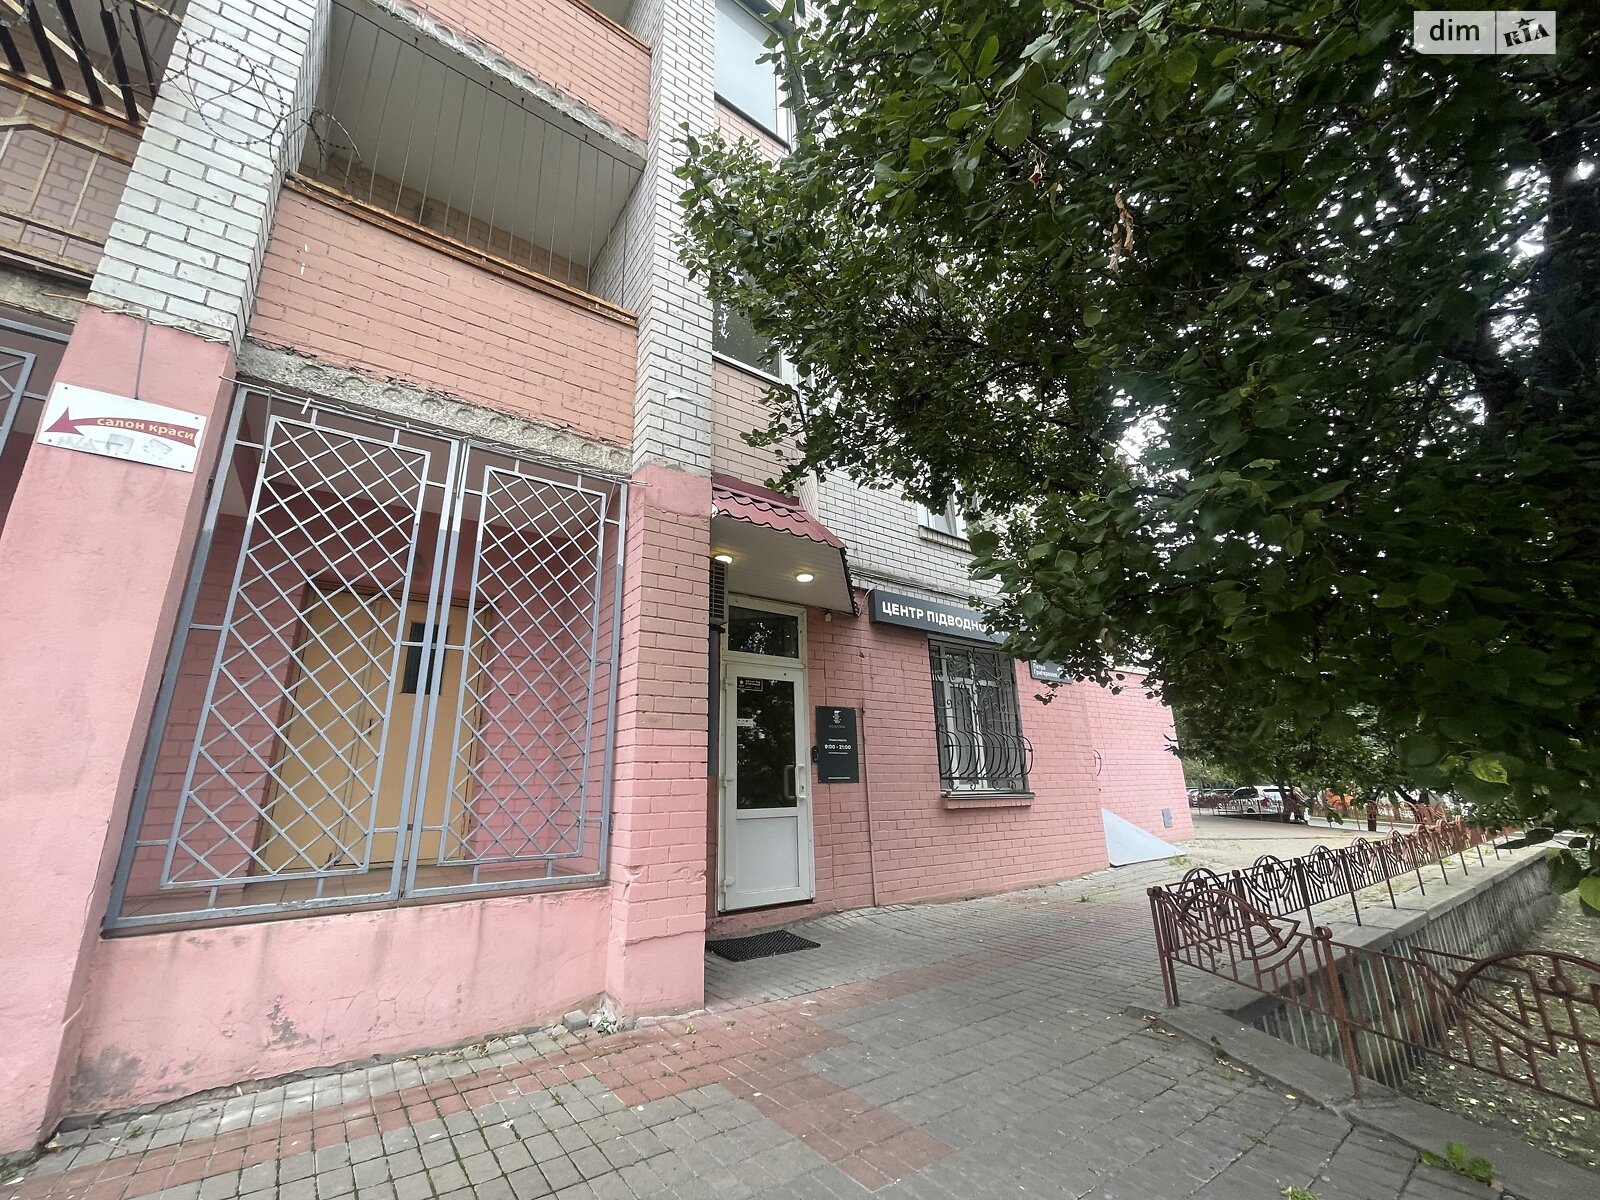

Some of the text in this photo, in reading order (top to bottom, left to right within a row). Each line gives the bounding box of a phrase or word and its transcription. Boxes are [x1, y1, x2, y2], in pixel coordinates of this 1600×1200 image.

[97, 418, 194, 440] салон краси
[882, 601, 924, 620] ЦЕНТР
[927, 611, 999, 635] ПІДВОДНО
